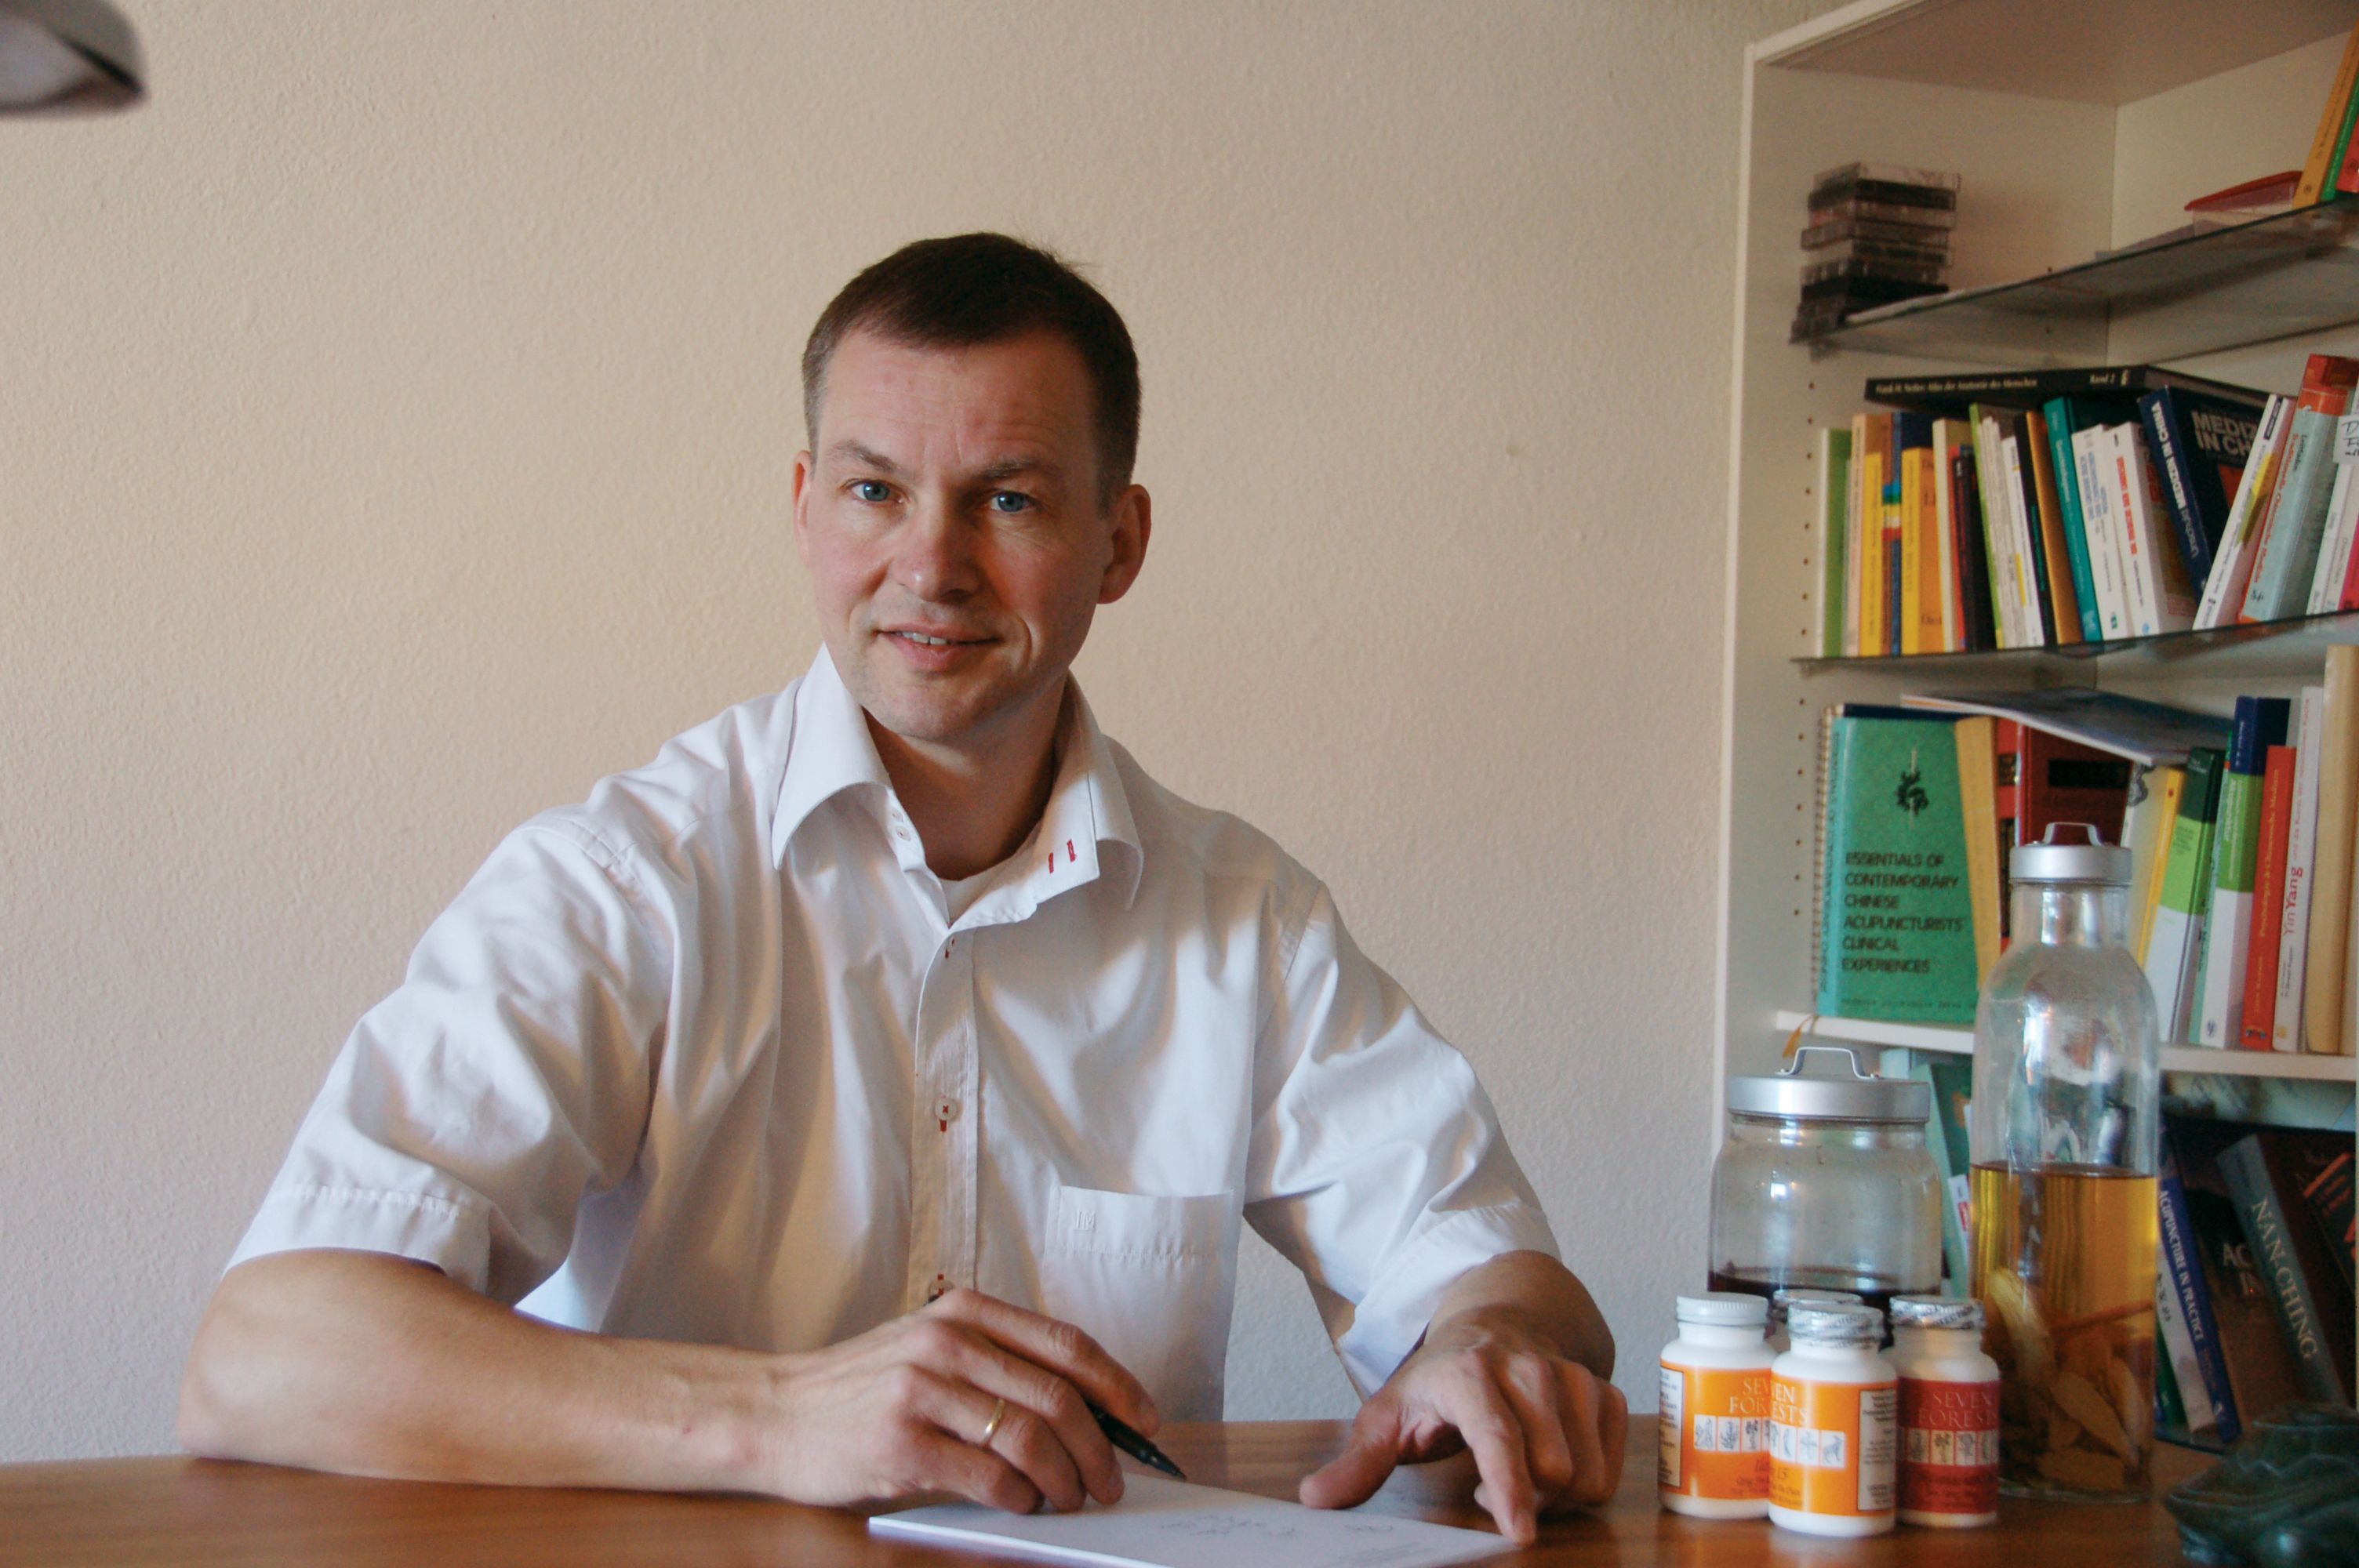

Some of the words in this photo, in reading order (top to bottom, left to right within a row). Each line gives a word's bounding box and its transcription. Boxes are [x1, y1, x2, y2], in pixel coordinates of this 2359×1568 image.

[2151, 400, 2170, 443] CHINA
[2190, 408, 2258, 441] MEDIZ
[1845, 851, 1921, 867] ESSENTIALS
[1925, 853, 1945, 867] OF
[1845, 873, 1959, 889] CONTEMPORARY
[1844, 894, 1900, 909] CHINESE
[1844, 915, 1964, 931] ACUPUNCTURISTS
[1843, 936, 1900, 952] CLINICAL
[1841, 957, 1931, 973] EXPERIENCES
[2159, 1190, 2186, 1272] ACUPUNCTURE
[2179, 1271, 2191, 1287] IN
[2250, 1197, 2288, 1269] NAN
[2275, 1266, 2319, 1360] CHING
[2182, 1287, 2205, 1342] PRACTICE
[1743, 1377, 1769, 1396] SEV
[1932, 1391, 1995, 1409] SEVEN
[1771, 1399, 1809, 1425] ESTS
